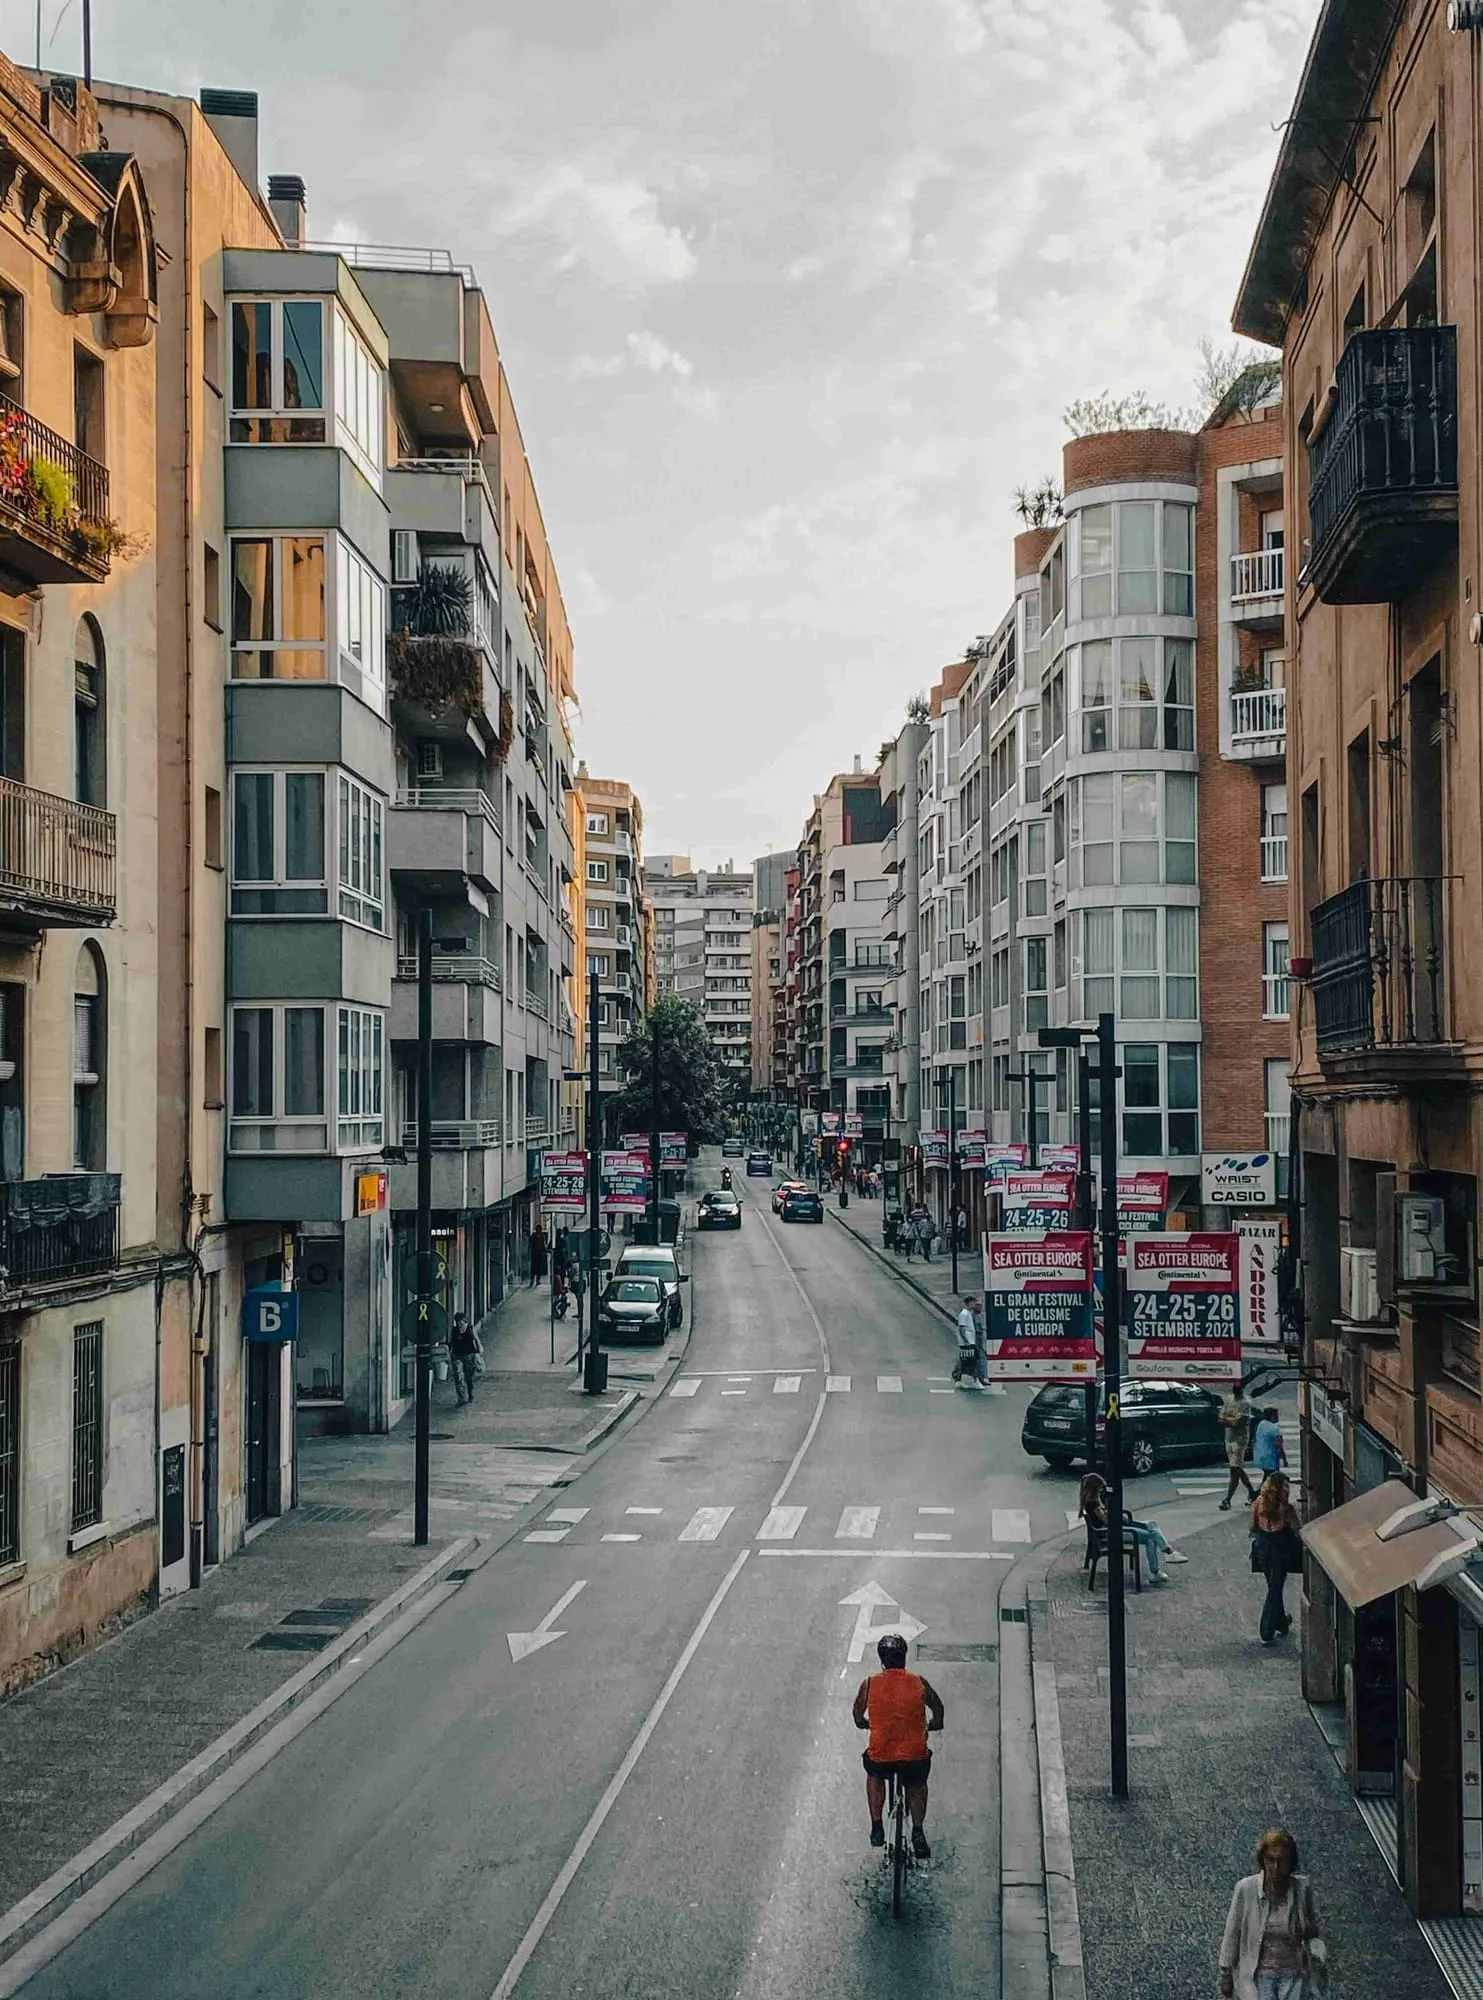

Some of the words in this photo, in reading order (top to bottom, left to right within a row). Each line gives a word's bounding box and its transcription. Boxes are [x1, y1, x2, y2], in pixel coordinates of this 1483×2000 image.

[1215, 1175, 1261, 1184] WRIST
[1211, 1191, 1266, 1202] CASIO
[1006, 1209, 1068, 1227] 24-25-26
[994, 1252, 1012, 1267] SEA
[1014, 1252, 1045, 1266] OTTER
[1046, 1252, 1083, 1267] EUROPE
[1137, 1252, 1157, 1268] SEA
[1158, 1252, 1189, 1267] OTTER
[1191, 1252, 1228, 1268] EUROPE
[994, 1294, 1006, 1307] EL
[1008, 1293, 1036, 1307] GRAN
[1039, 1293, 1085, 1307] FESTIVAL
[1133, 1293, 1234, 1321] 24-25-26
[1008, 1308, 1021, 1321] DE
[1023, 1308, 1071, 1321] CICLISME
[1015, 1323, 1022, 1336] A
[1025, 1323, 1065, 1336] EUROPA
[1134, 1321, 1202, 1337] SETEMBRE
[1205, 1322, 1234, 1338] 2021
